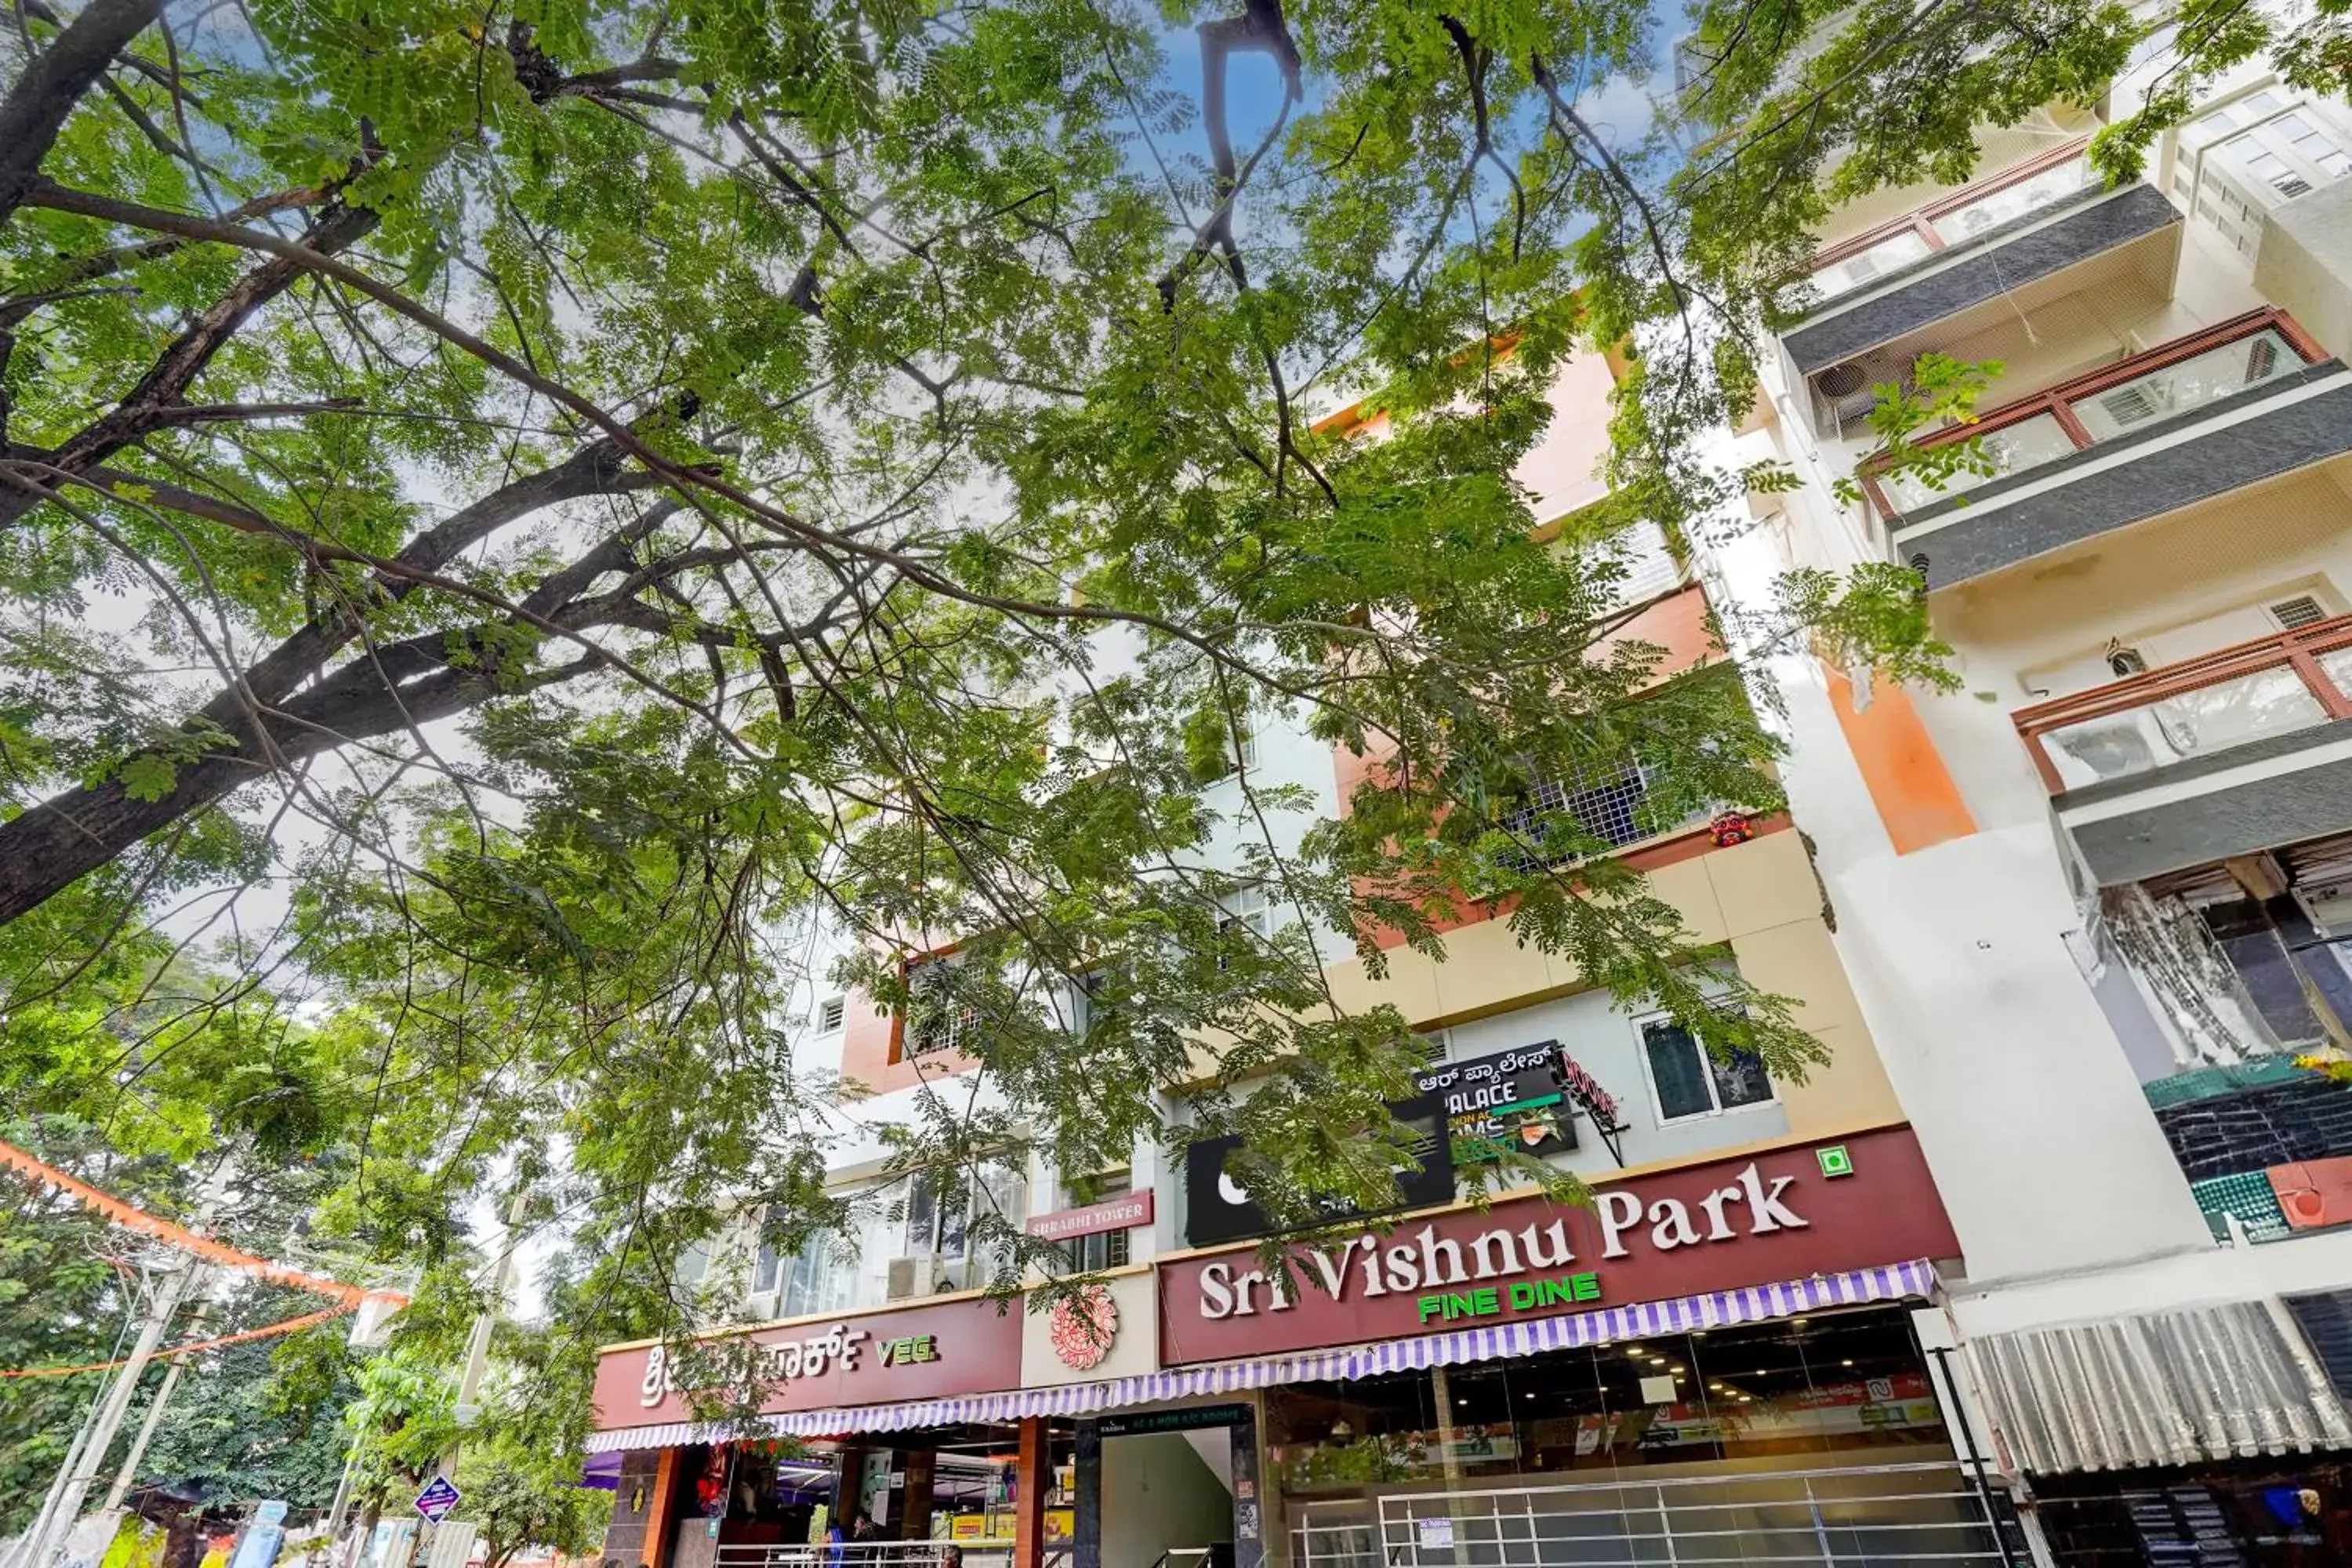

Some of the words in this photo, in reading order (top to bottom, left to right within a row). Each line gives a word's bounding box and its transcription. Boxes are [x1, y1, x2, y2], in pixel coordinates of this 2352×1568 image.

[1445, 1081, 1518, 1115] ALACE
[1094, 1203, 1143, 1226] TOWER
[1200, 1256, 1290, 1319] Sri
[1305, 1218, 1577, 1302] Vishnu
[1591, 1162, 1809, 1259] Park
[1417, 1287, 1500, 1323] FINE
[1510, 1272, 1601, 1312] DINE
